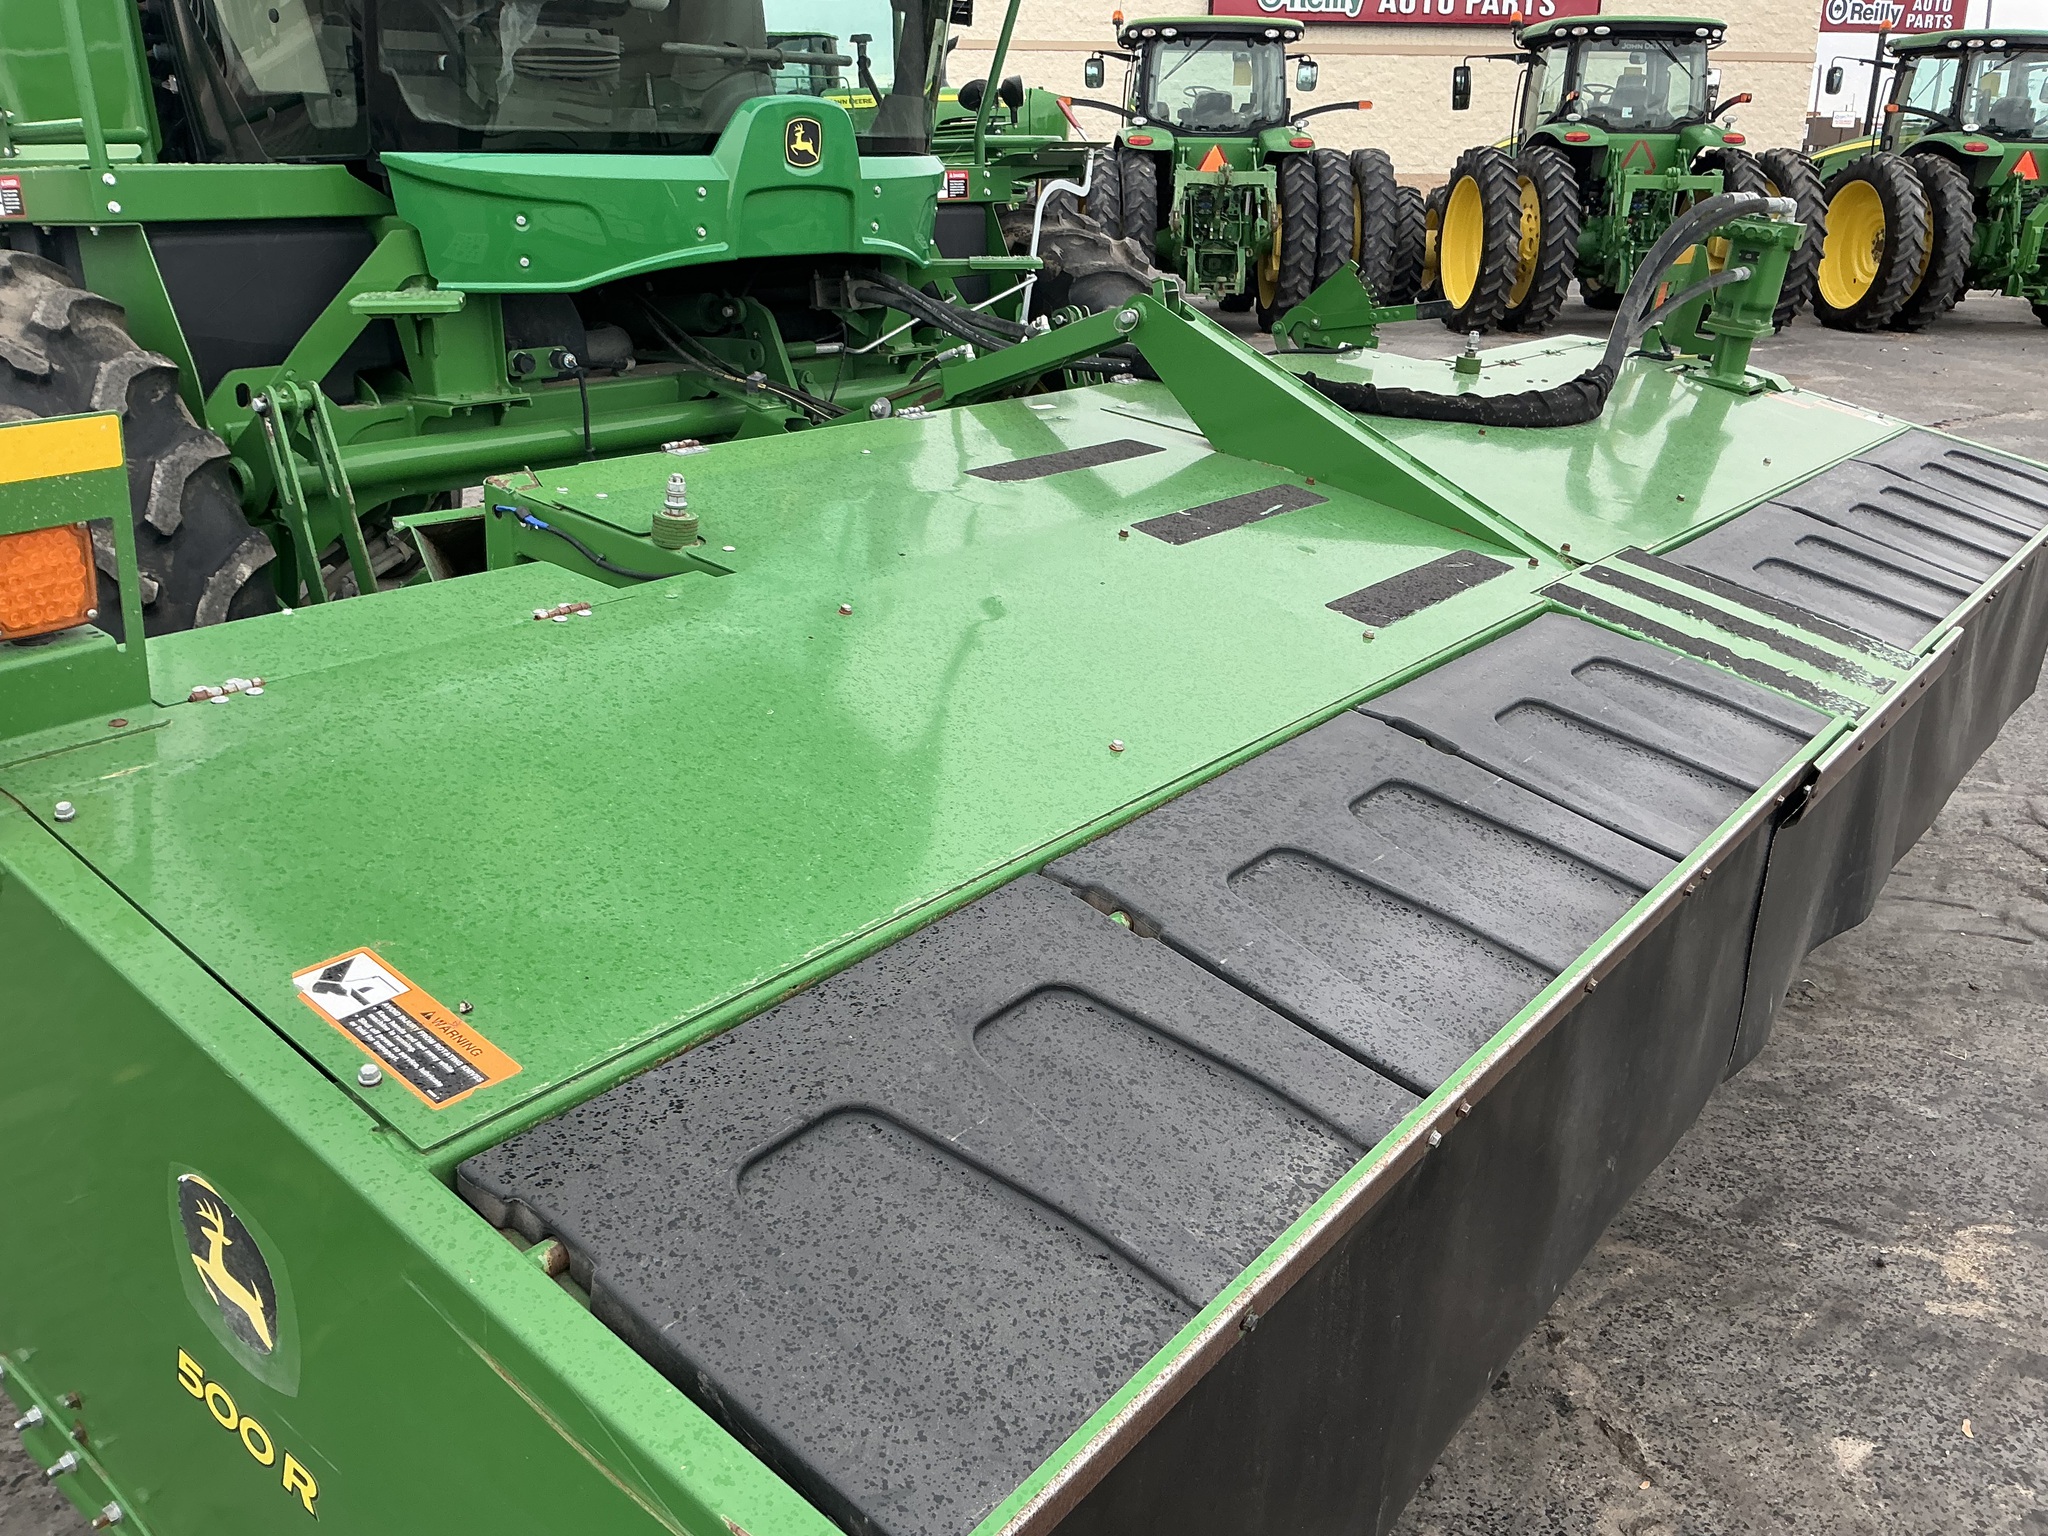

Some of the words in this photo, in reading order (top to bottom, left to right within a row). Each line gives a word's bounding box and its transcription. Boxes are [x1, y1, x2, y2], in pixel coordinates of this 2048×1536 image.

[1905, 14, 1953, 29] PARTS
[1912, 0, 1953, 12] AUTO
[382, 1002, 402, 1016] AVOID
[417, 1031, 437, 1044] FROM
[433, 1043, 464, 1066] ROTATING
[460, 1065, 485, 1082] KNIVES
[432, 1017, 483, 1057] WARNING
[177, 1345, 276, 1467] 500
[282, 1448, 320, 1521] R
